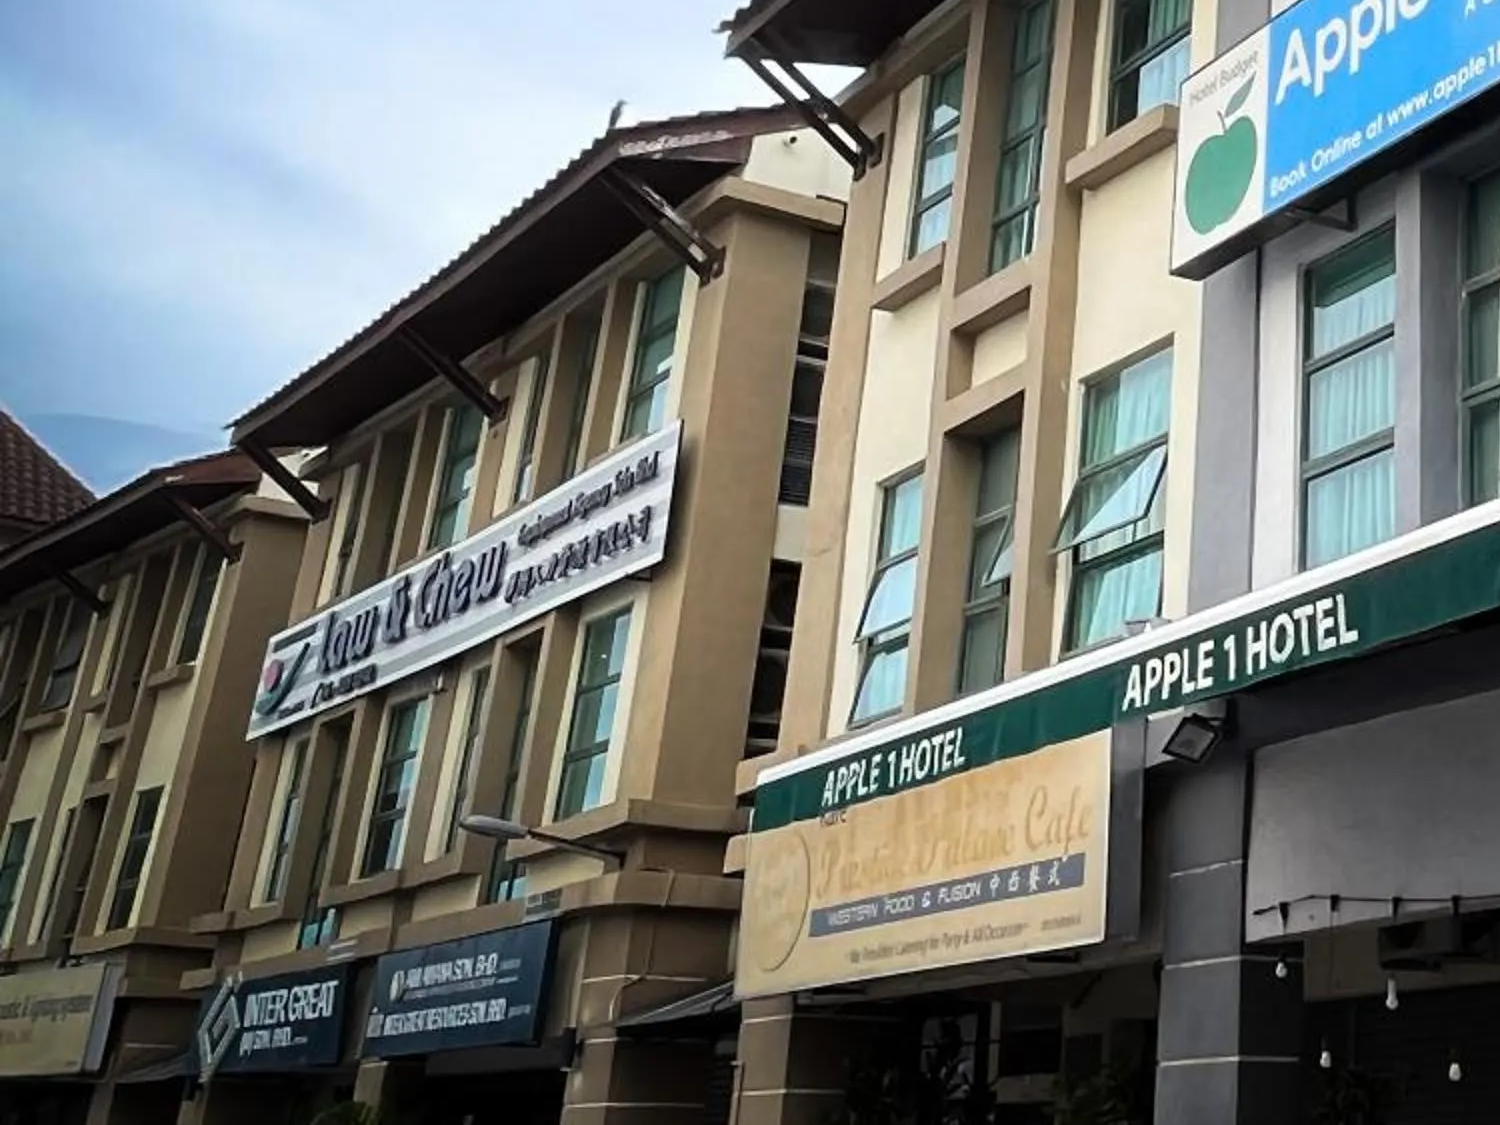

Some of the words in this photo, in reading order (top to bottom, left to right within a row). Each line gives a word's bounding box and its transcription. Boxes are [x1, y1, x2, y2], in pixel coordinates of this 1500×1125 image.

[1269, 161, 1307, 198] Book
[1311, 130, 1362, 172] Online
[1366, 114, 1382, 139] at
[1122, 639, 1215, 711] APPLE
[1223, 634, 1236, 681] 1
[1245, 593, 1358, 675] HOTEL
[821, 752, 881, 807] APPLE
[887, 753, 896, 788] 1
[900, 727, 966, 785] HOTEL
[1025, 784, 1094, 854] Cafe
[828, 902, 879, 926] WESTERN
[883, 894, 915, 916] FOOD
[937, 881, 982, 905] FUSION
[243, 988, 289, 1028] INTER
[288, 980, 340, 1022] GREAT
